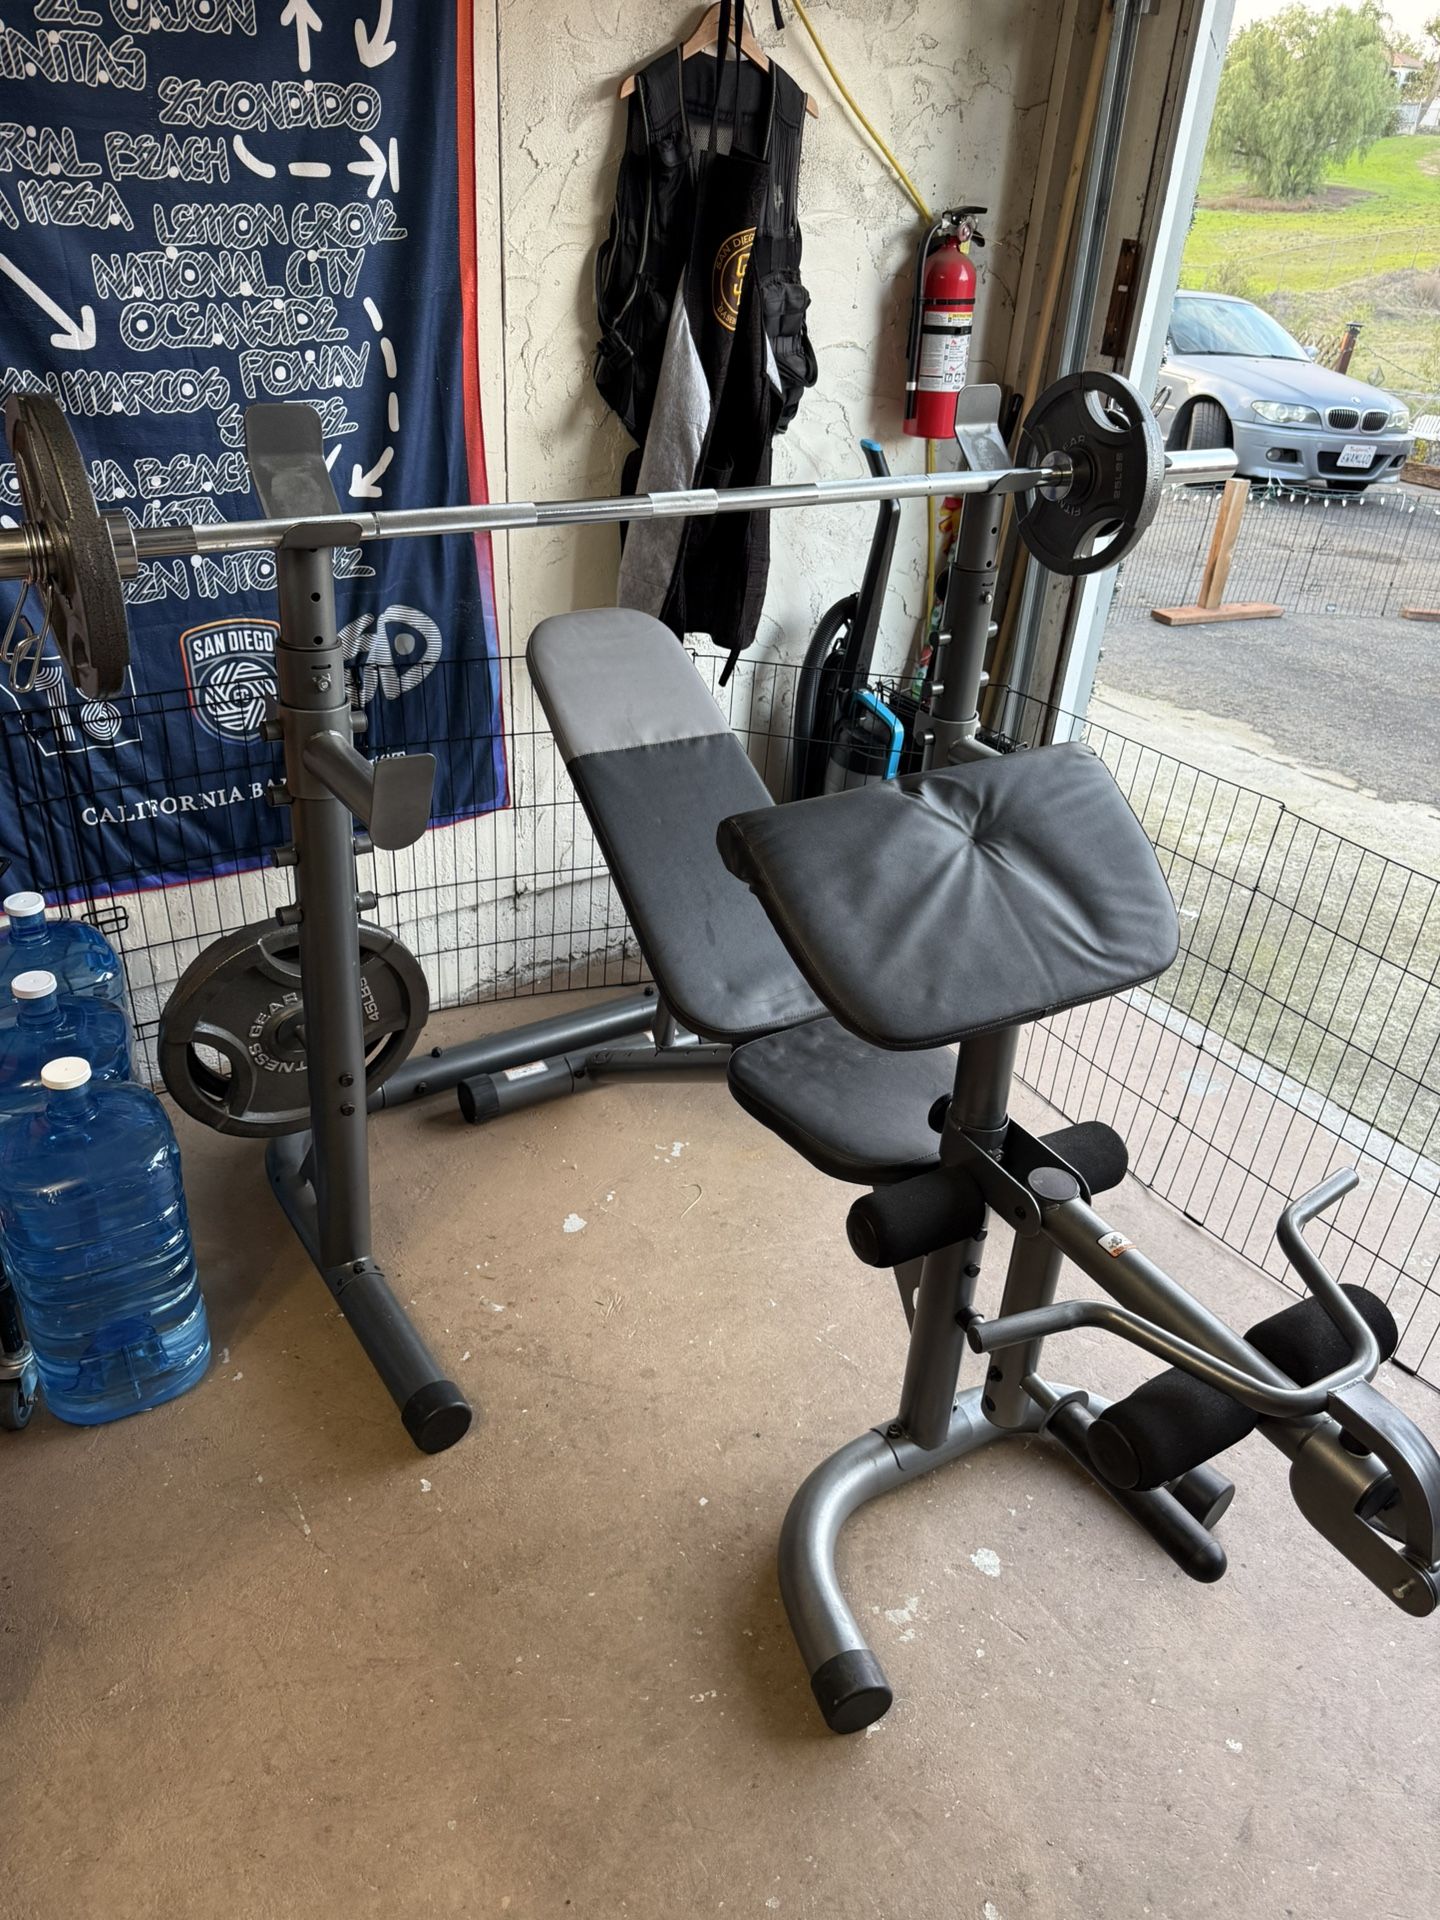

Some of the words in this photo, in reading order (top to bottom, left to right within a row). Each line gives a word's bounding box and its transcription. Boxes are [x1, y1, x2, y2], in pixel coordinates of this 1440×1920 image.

[0, 28, 146, 91] INITAS
[158, 76, 382, 132] ESCONDIDO
[104, 131, 230, 183] BEACH
[17, 179, 134, 232] MESA
[153, 203, 290, 249] LEMON
[291, 200, 408, 249] GROVE
[732, 232, 755, 249] DIEG
[91, 246, 285, 300] NATIONAL
[285, 248, 365, 298] CITY
[120, 297, 349, 351] OCEANSIDE
[61, 368, 230, 416] MARCOS
[239, 341, 370, 398] POWAY
[191, 550, 278, 599] INTO
[193, 632, 226, 662] SAN
[227, 629, 274, 653] DIEGO
[82, 785, 245, 826] CALIFORNIA
[248, 992, 298, 1038] GEAR
[360, 976, 380, 1021] 45LBS
[248, 1042, 308, 1073] TNESS
